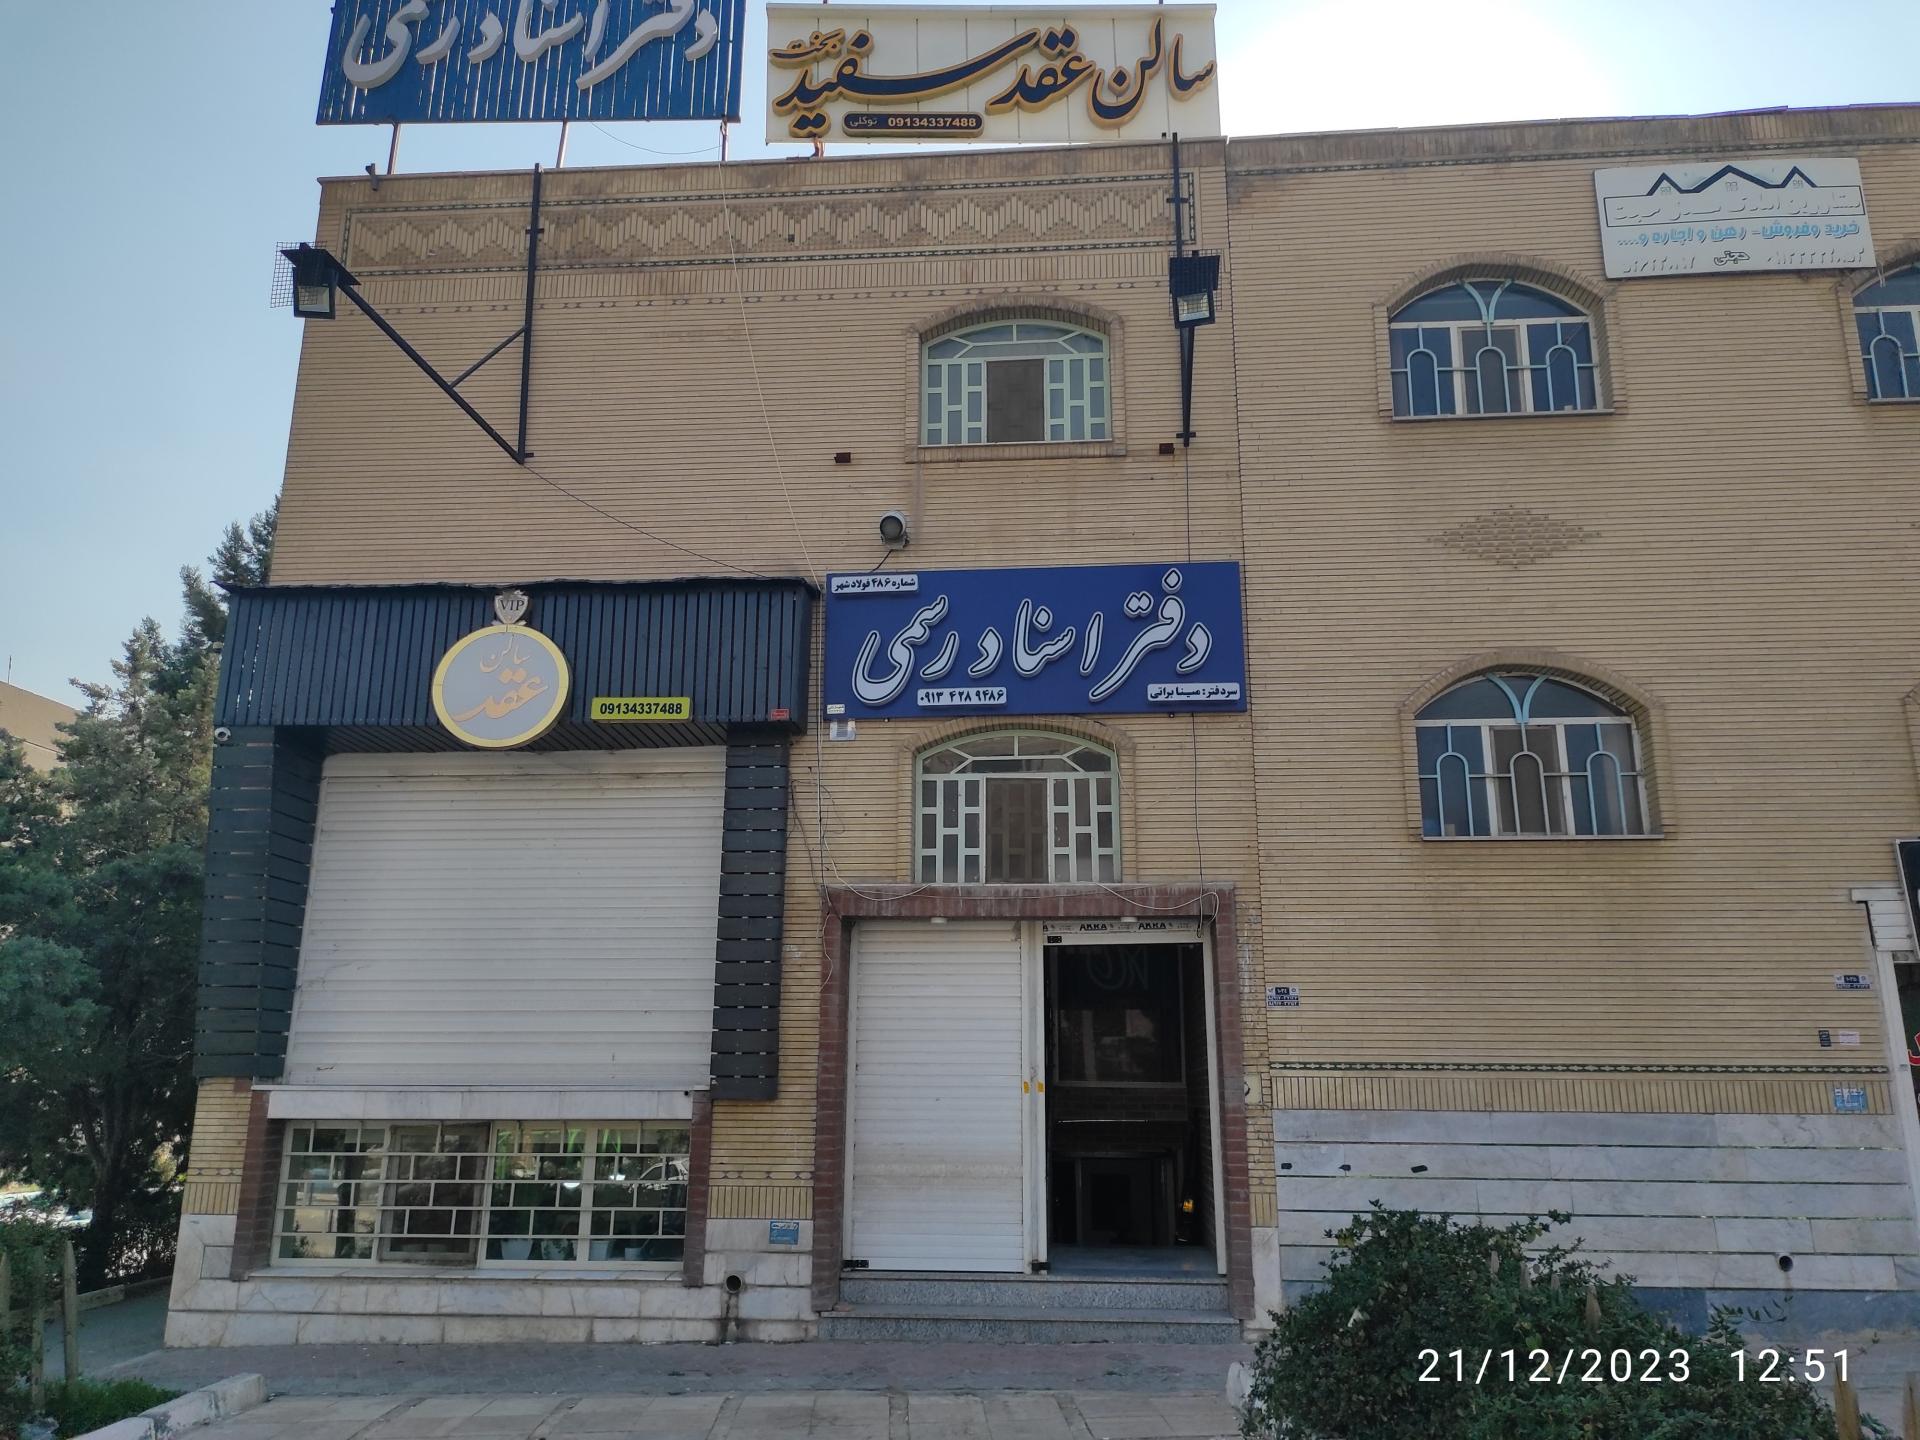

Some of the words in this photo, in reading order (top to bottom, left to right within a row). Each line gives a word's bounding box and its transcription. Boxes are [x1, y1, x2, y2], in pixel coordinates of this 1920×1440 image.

[773, 27, 1041, 138] سفید
[985, 24, 1096, 115] عقد
[1087, 15, 1216, 129] سالن
[888, 117, 977, 127] 09134337488
[1653, 225, 1693, 246] اجاره
[1710, 223, 1747, 242] رهن
[1825, 220, 1860, 236] خرید
[891, 577, 916, 590] شماره
[499, 599, 525, 611] VIP
[852, 594, 960, 706] رسمی
[968, 598, 1104, 678] اسناد
[1089, 568, 1213, 702] دفتر
[480, 632, 530, 673] سالن
[451, 668, 549, 722] عقد
[1175, 686, 1201, 698] مینا
[599, 702, 682, 715] 09134337488
